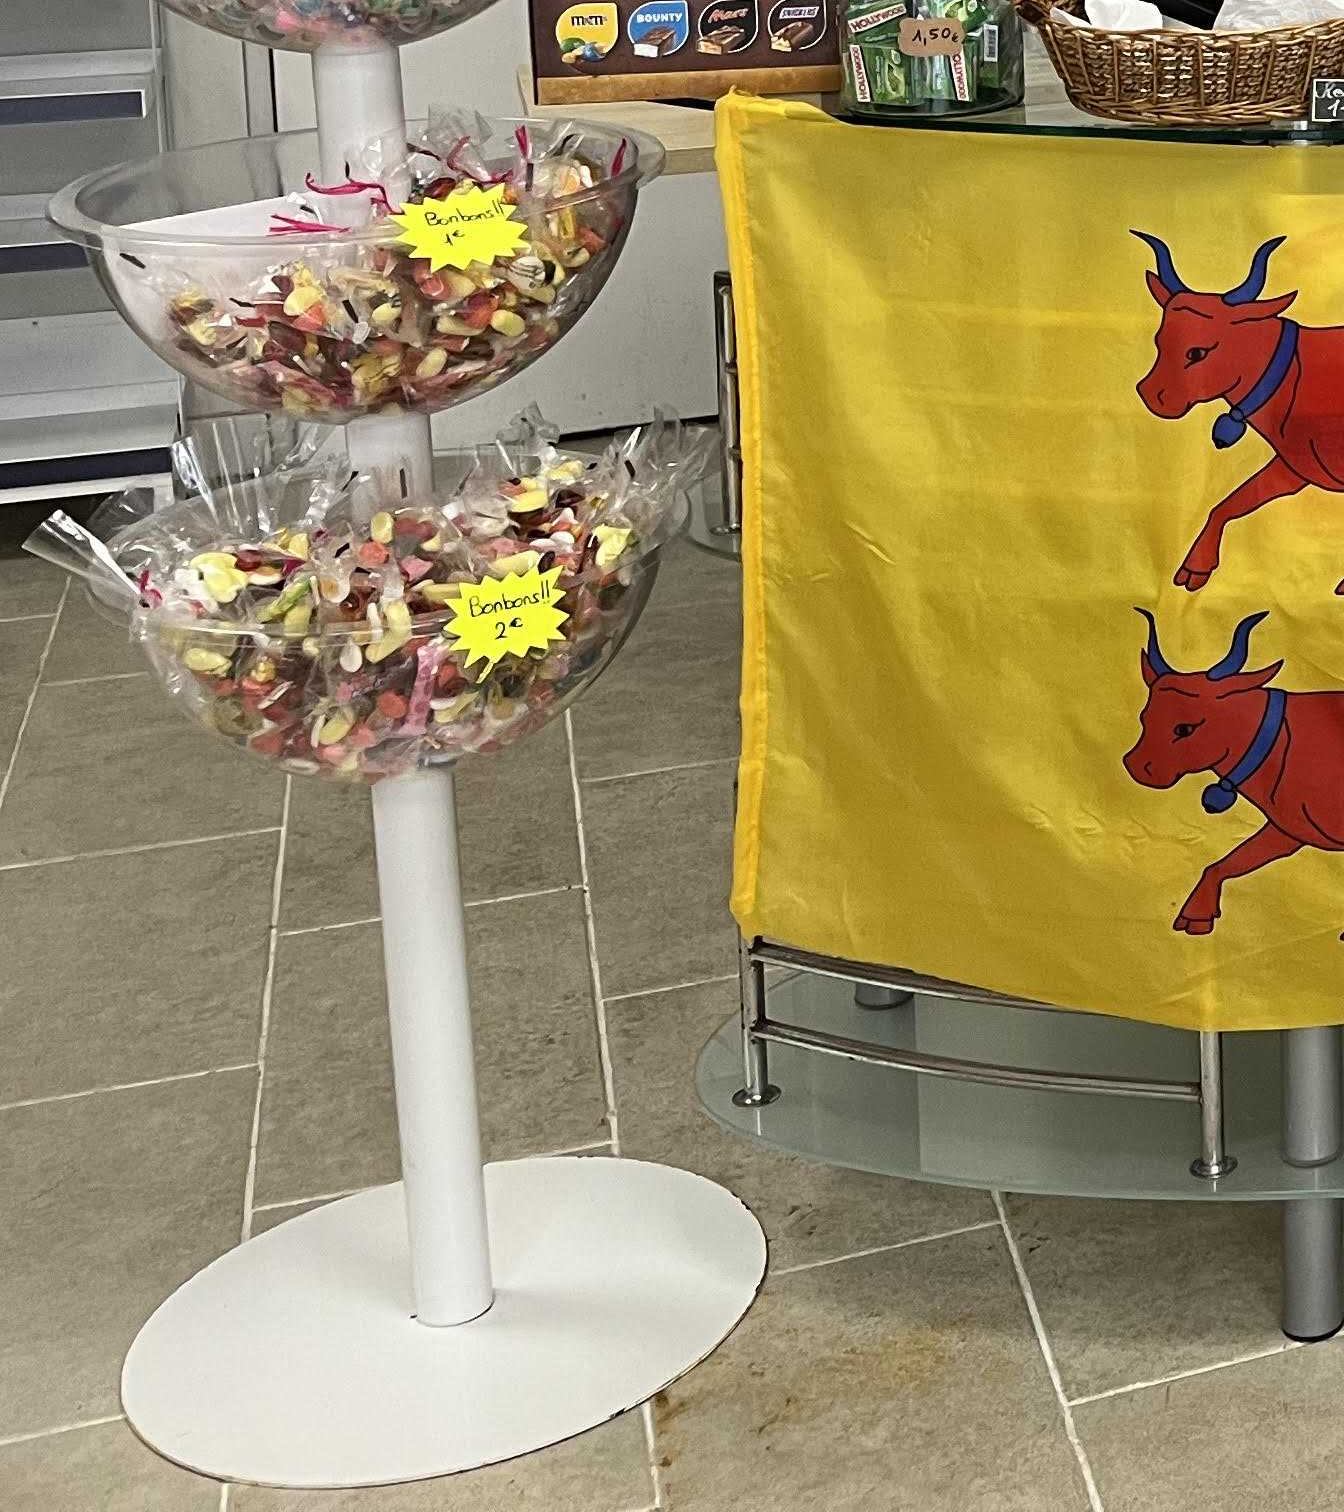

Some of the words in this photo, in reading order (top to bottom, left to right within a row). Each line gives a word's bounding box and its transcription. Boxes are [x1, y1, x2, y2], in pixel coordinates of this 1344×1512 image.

[636, 11, 683, 24] BOUNTY
[851, 4, 906, 29] HOLLYWOOD
[851, 46, 869, 101] HOLLYWOOD
[953, 53, 967, 100] OLLYWOOD
[468, 579, 551, 618] Bonbons!!
[494, 617, 524, 640] 2€
